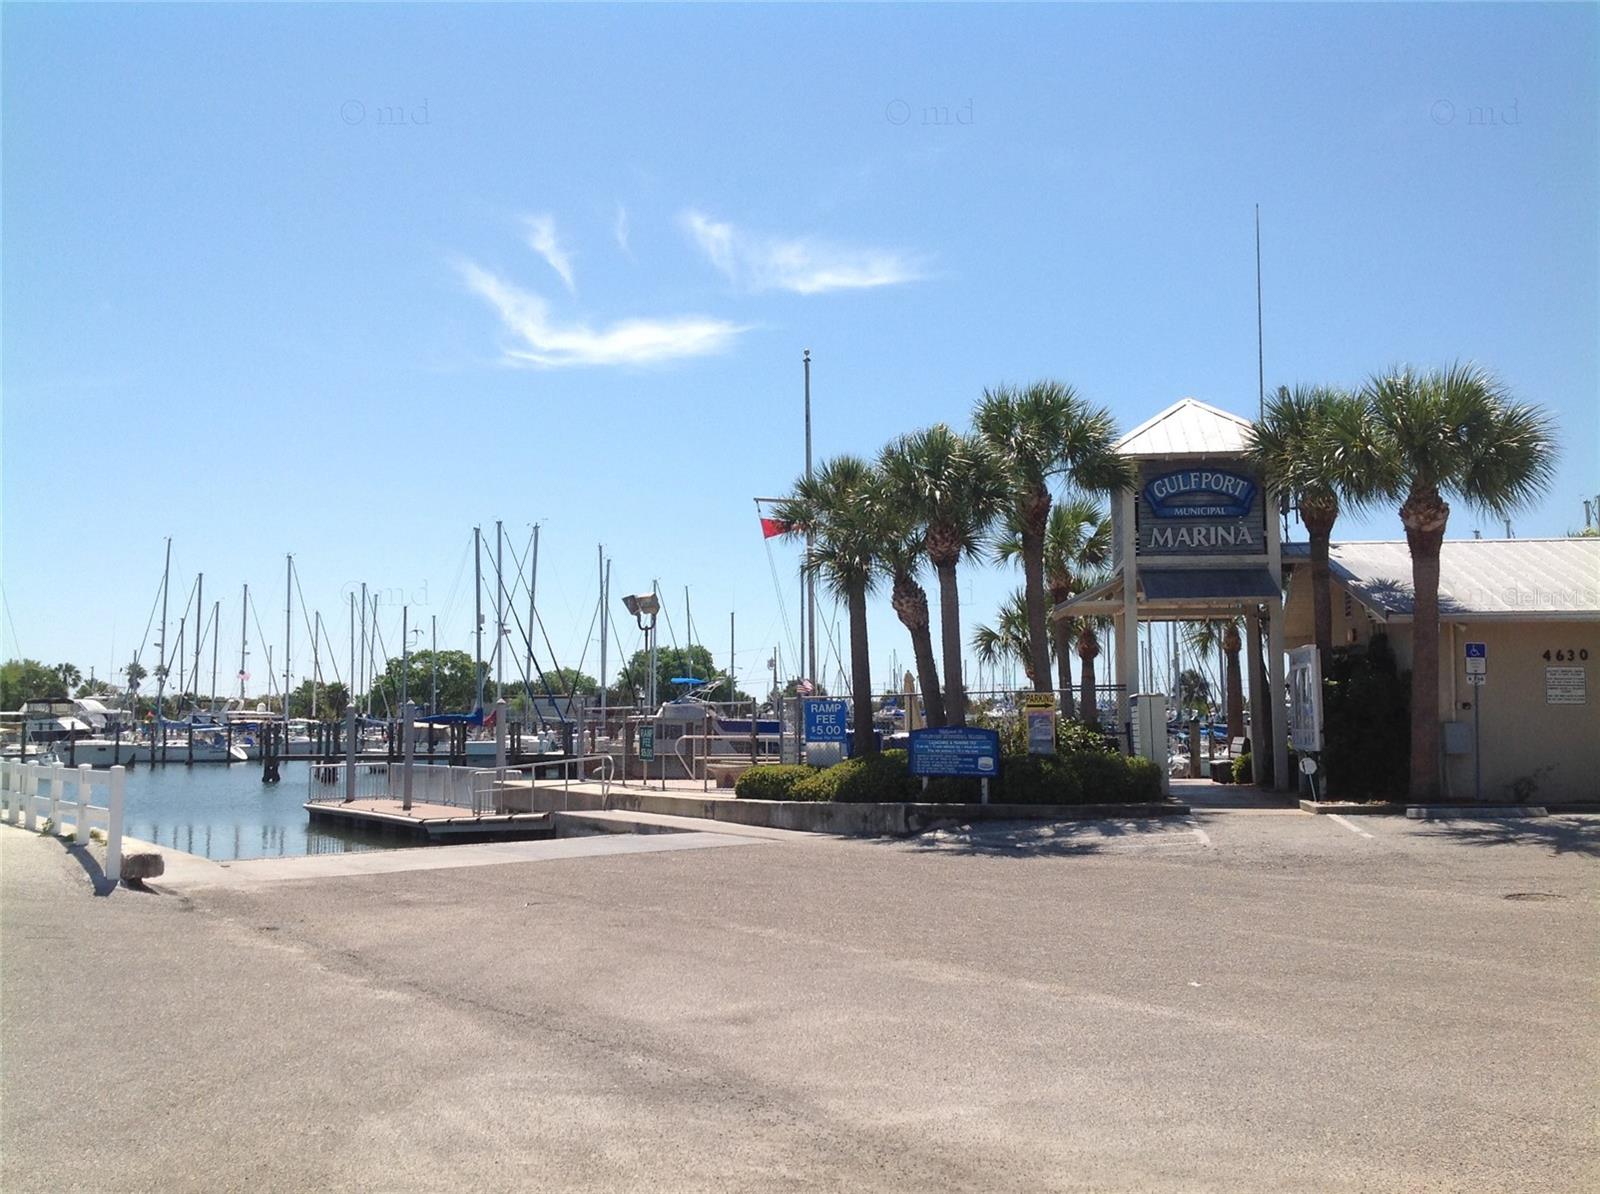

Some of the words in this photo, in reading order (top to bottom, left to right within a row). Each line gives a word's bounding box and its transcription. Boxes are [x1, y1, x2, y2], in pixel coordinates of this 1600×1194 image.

[1153, 472, 1248, 498] GULFPORT
[1174, 506, 1226, 515] MUNICIPAL
[1147, 526, 1253, 548] MARINA
[1542, 648, 1588, 662] 4630
[1025, 694, 1055, 704] PARKING
[811, 703, 842, 713] RAMP
[816, 714, 837, 724] FEE
[811, 725, 841, 735] $5.00
